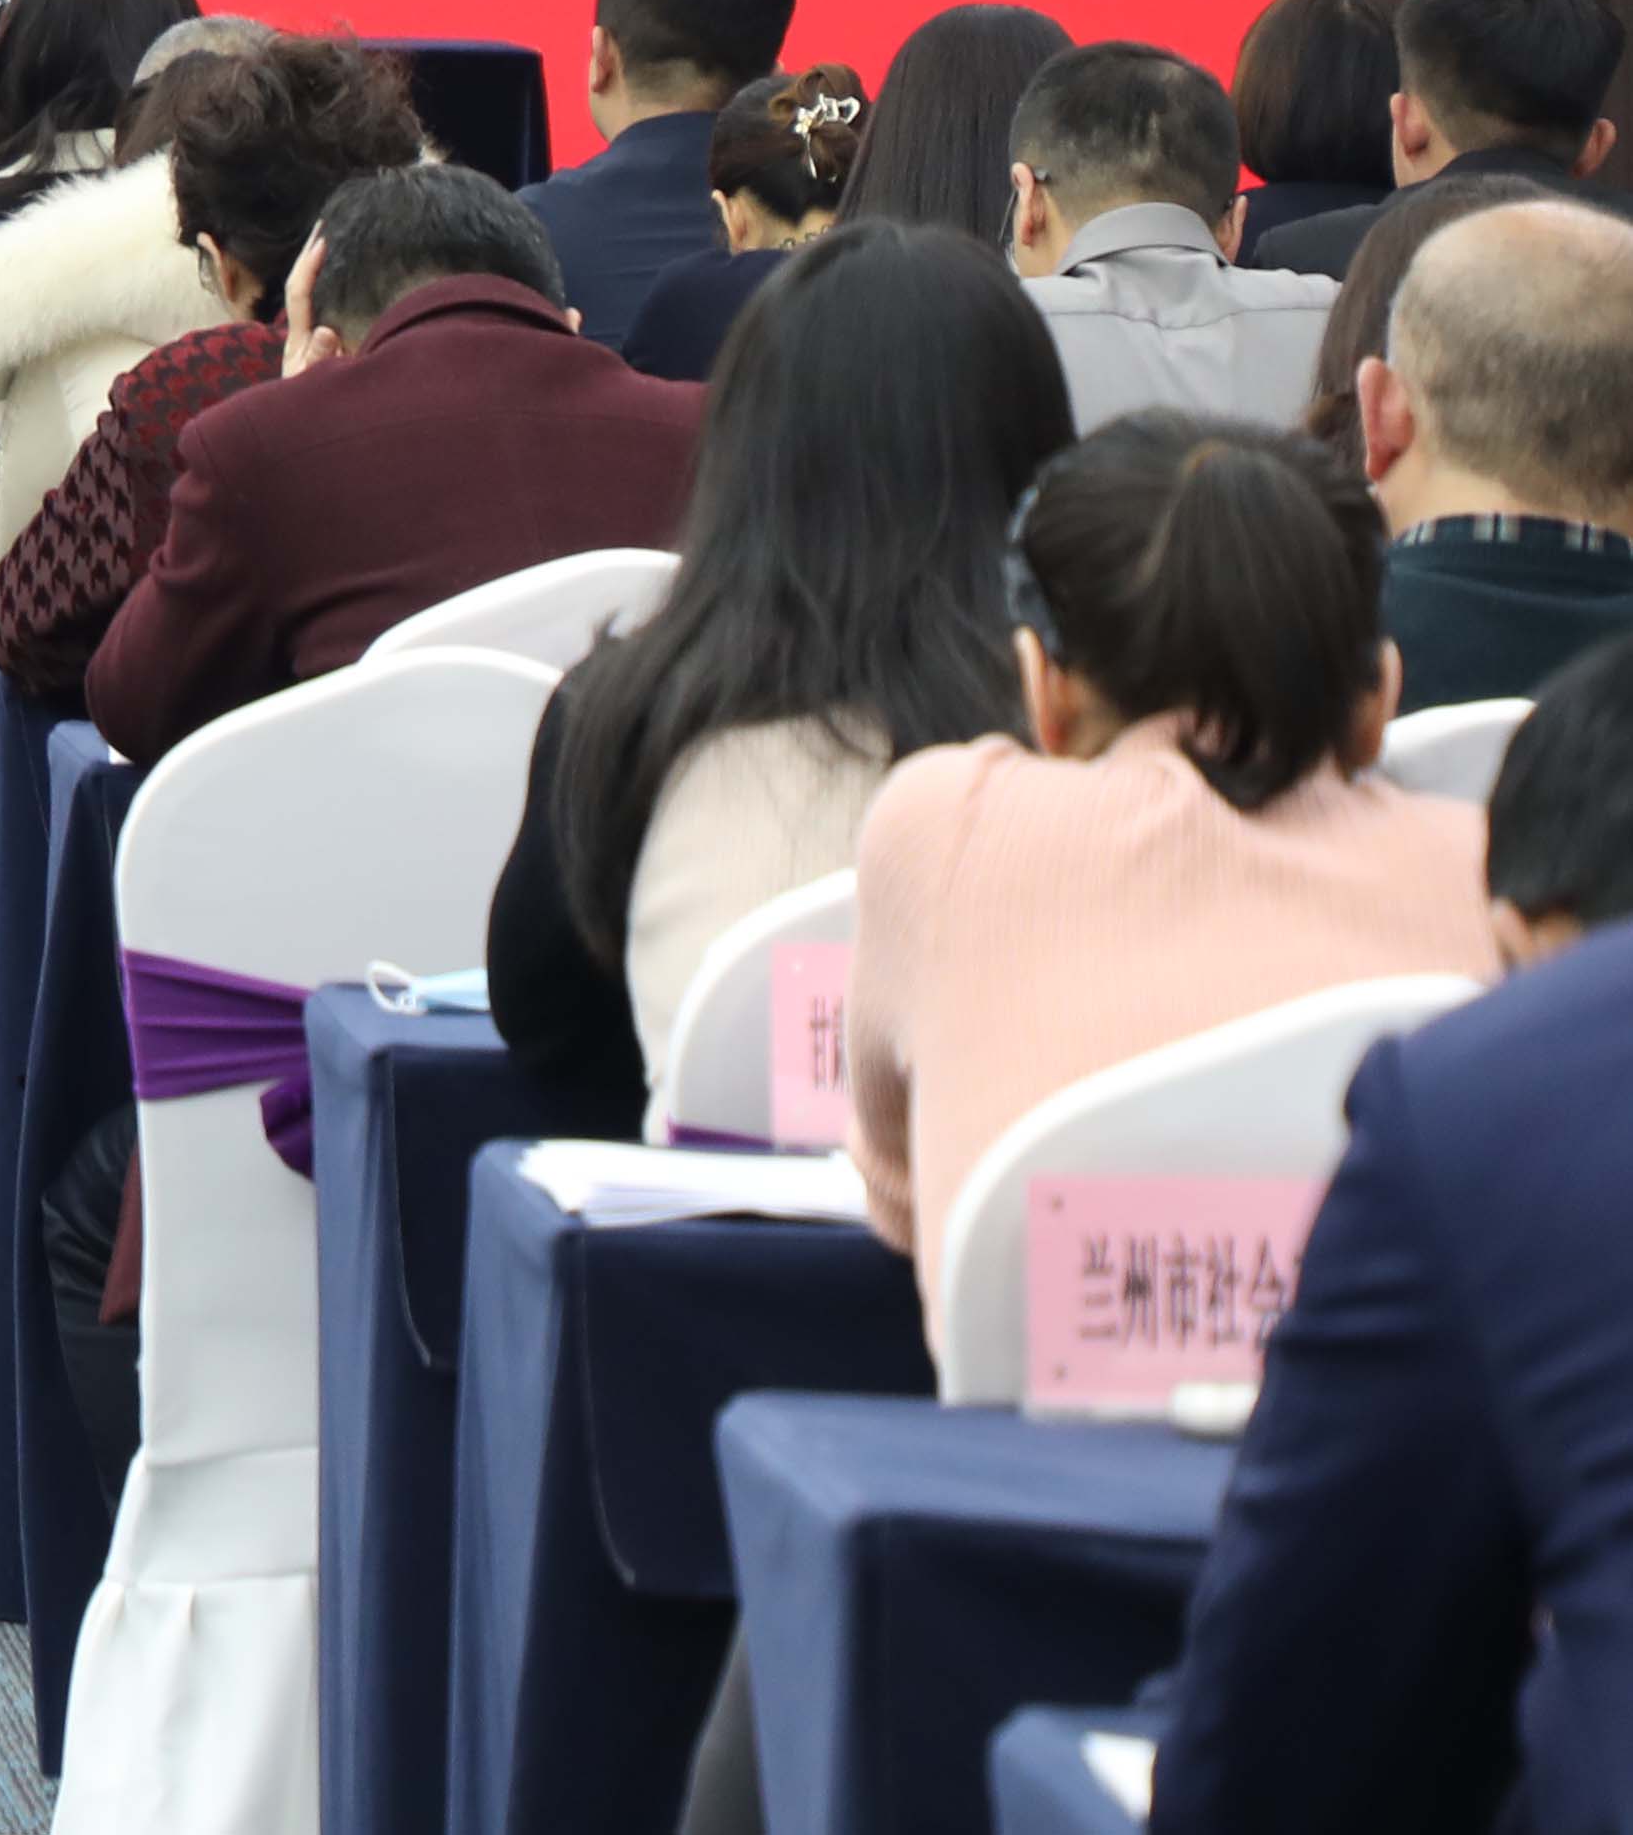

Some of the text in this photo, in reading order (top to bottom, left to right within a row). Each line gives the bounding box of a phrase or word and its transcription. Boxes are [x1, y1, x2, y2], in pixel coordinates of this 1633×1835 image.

[1077, 1232, 1301, 1351] 兰州市社会
